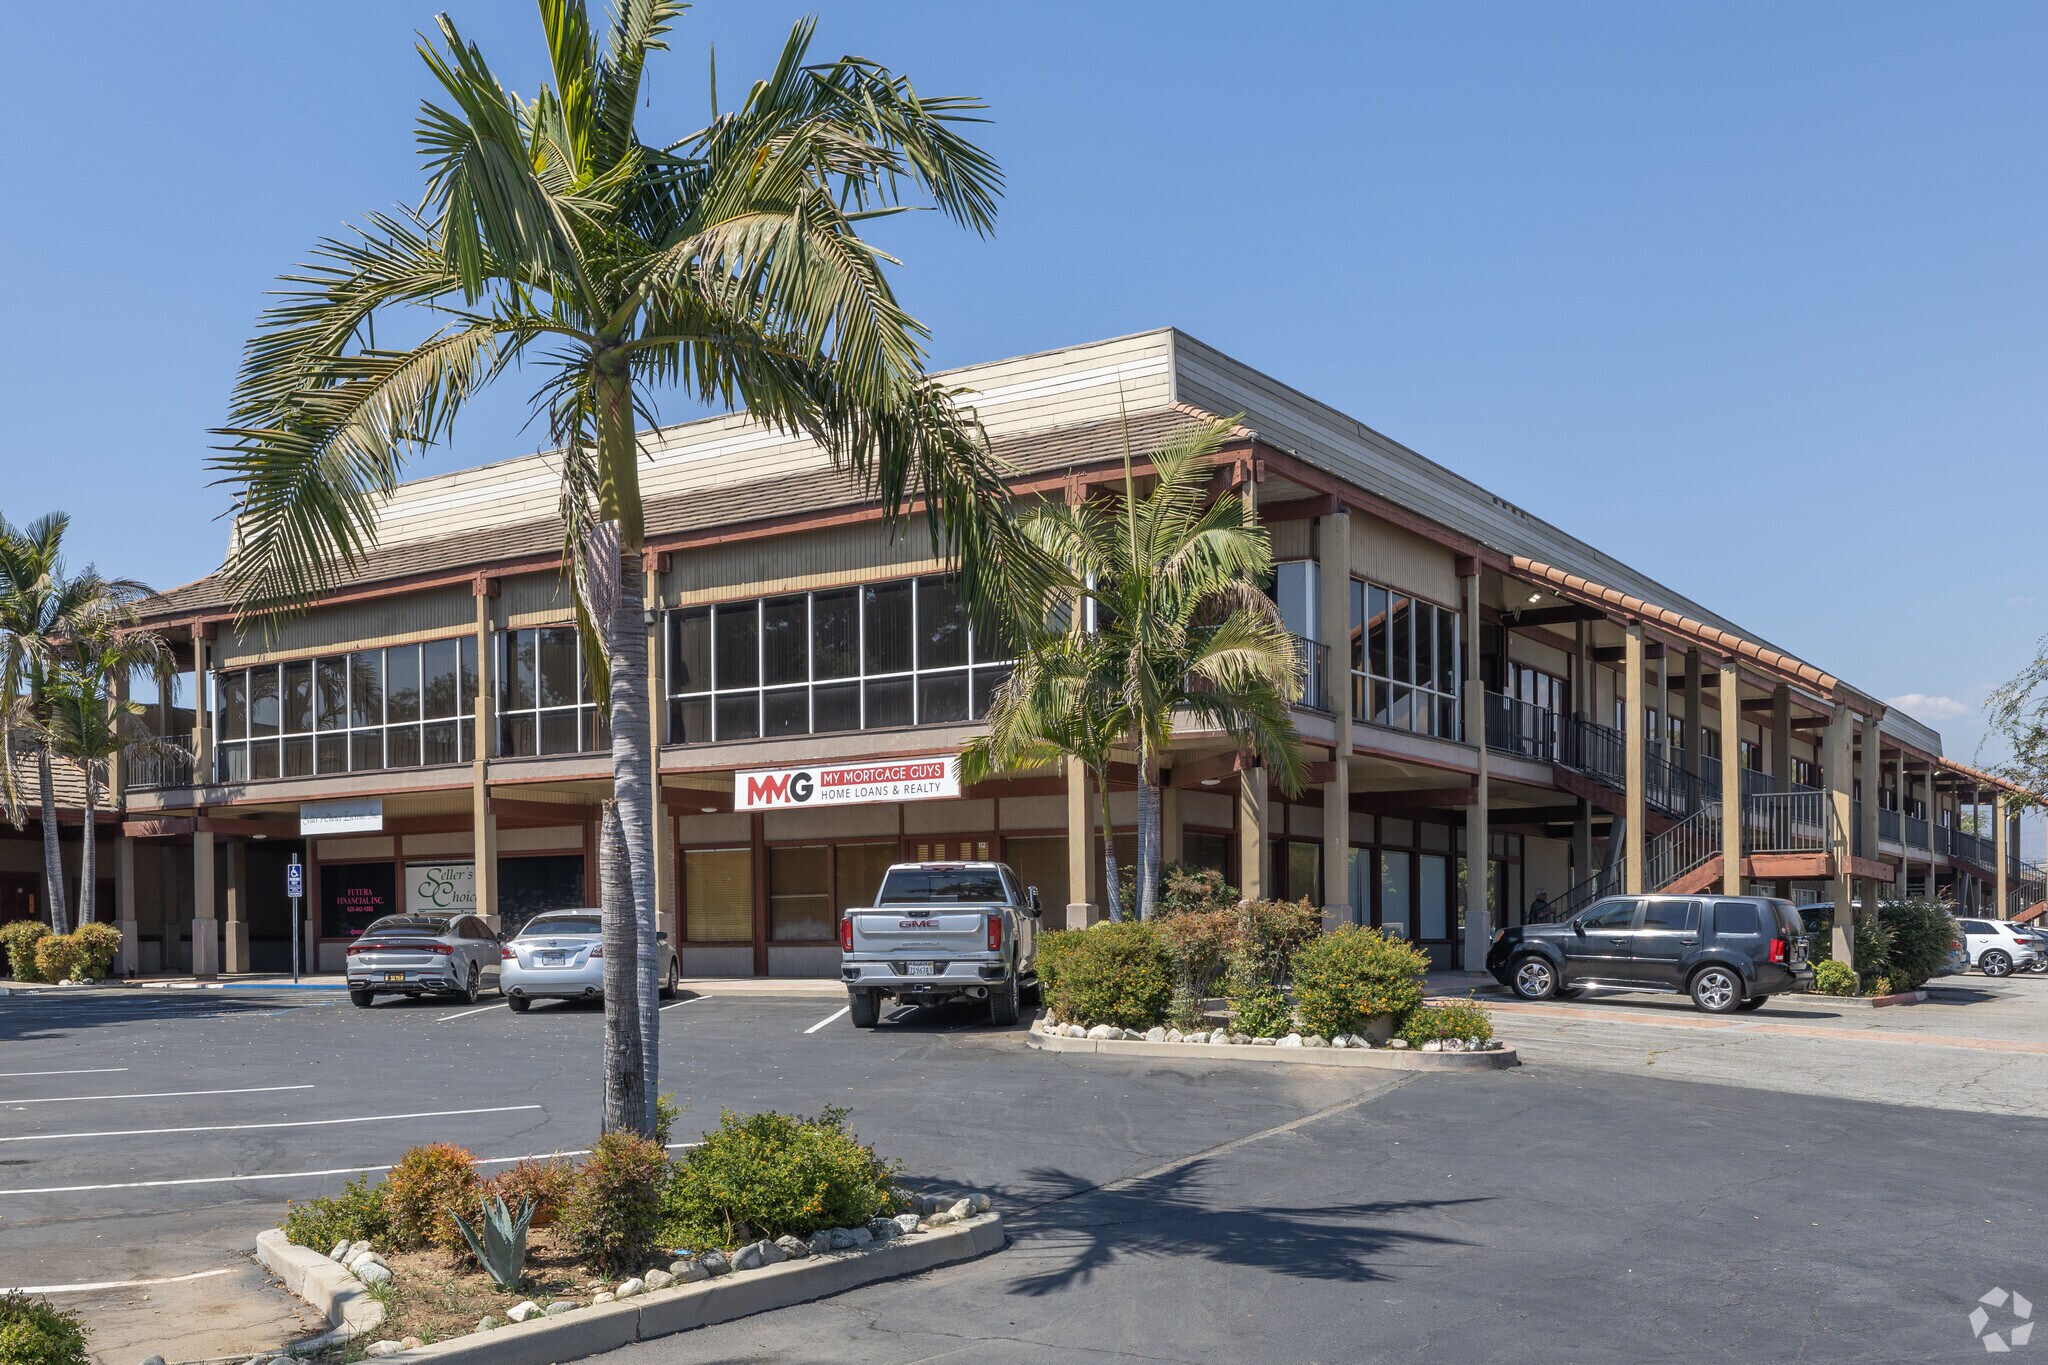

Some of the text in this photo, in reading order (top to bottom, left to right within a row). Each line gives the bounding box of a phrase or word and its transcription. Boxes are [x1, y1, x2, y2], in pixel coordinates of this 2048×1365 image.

[823, 764, 941, 785] MY MORTGAGE GUYS
[747, 772, 814, 806] MMG
[821, 782, 941, 800] HOME LOANS & REALTY
[336, 896, 384, 905] FINANCIAL INC.
[347, 888, 373, 896] FUTURA
[432, 881, 477, 907] Choic
[899, 919, 940, 928] GMC
